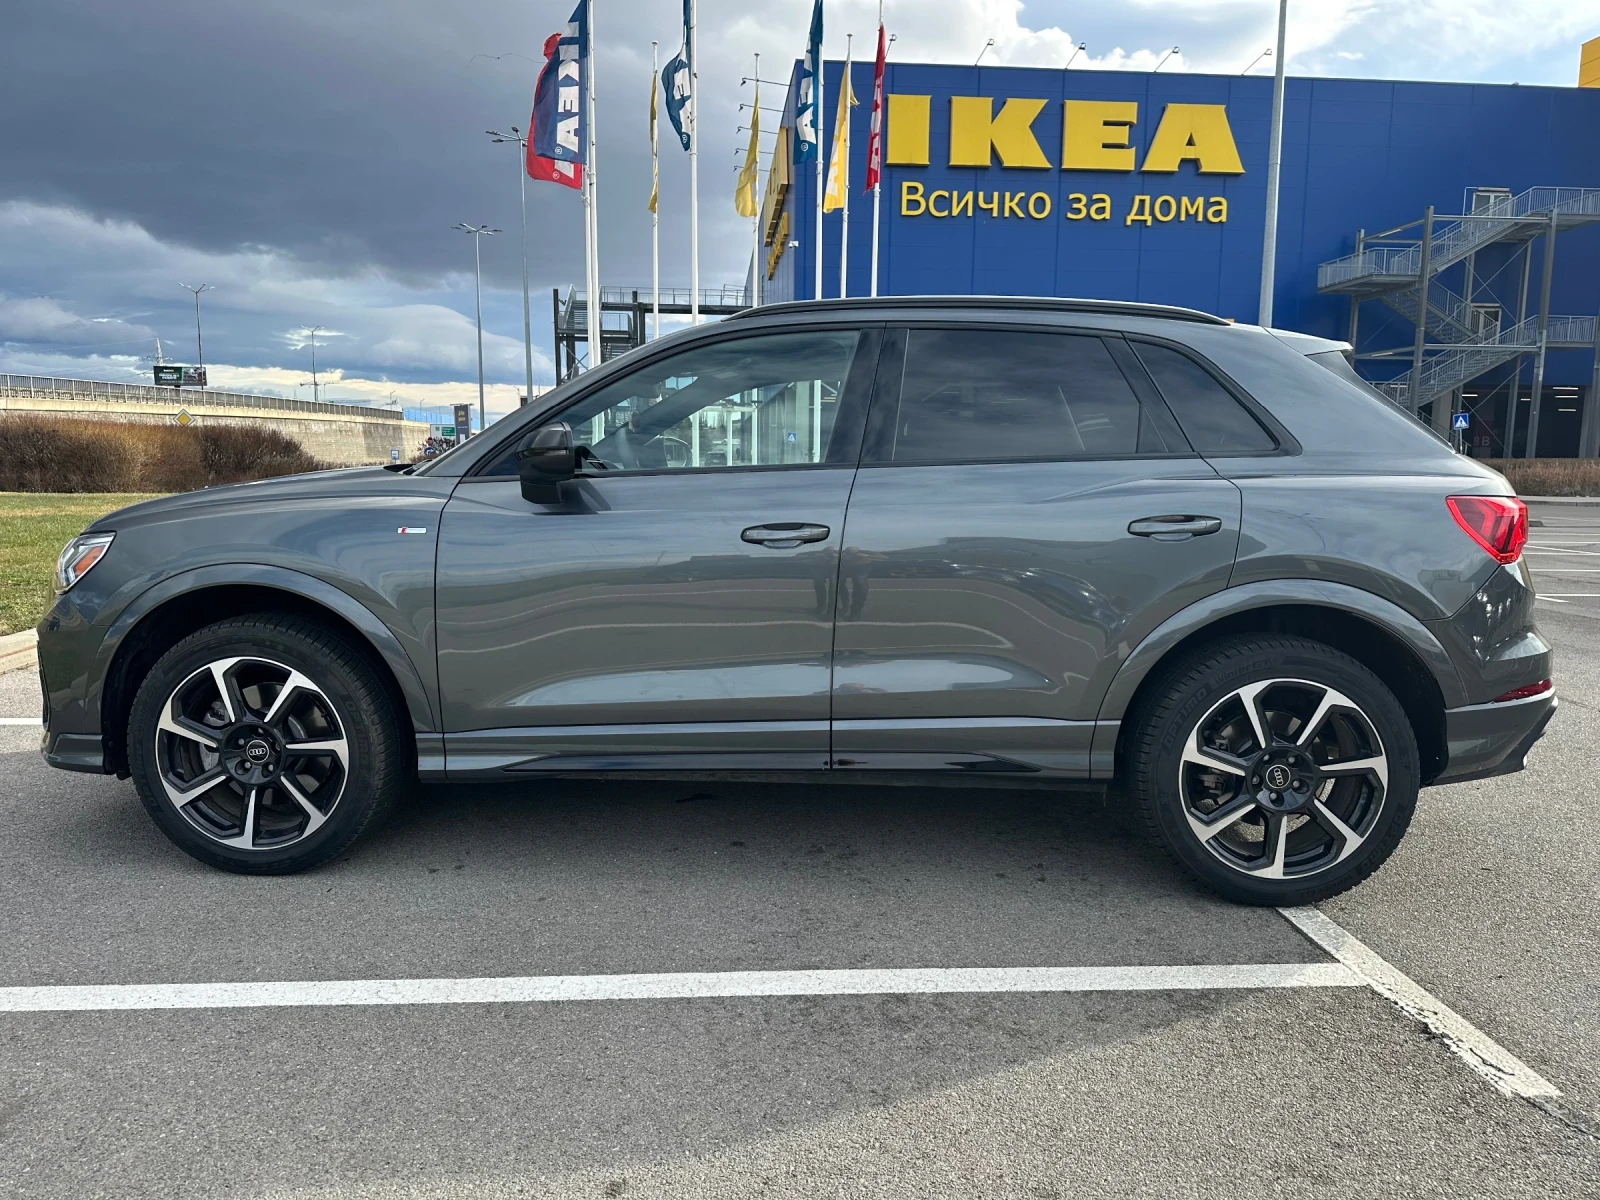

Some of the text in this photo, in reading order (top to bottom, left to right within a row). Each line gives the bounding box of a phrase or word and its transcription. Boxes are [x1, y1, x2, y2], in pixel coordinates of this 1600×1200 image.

[885, 93, 1246, 175] IKEA
[900, 181, 1228, 227] Всичко за дома
